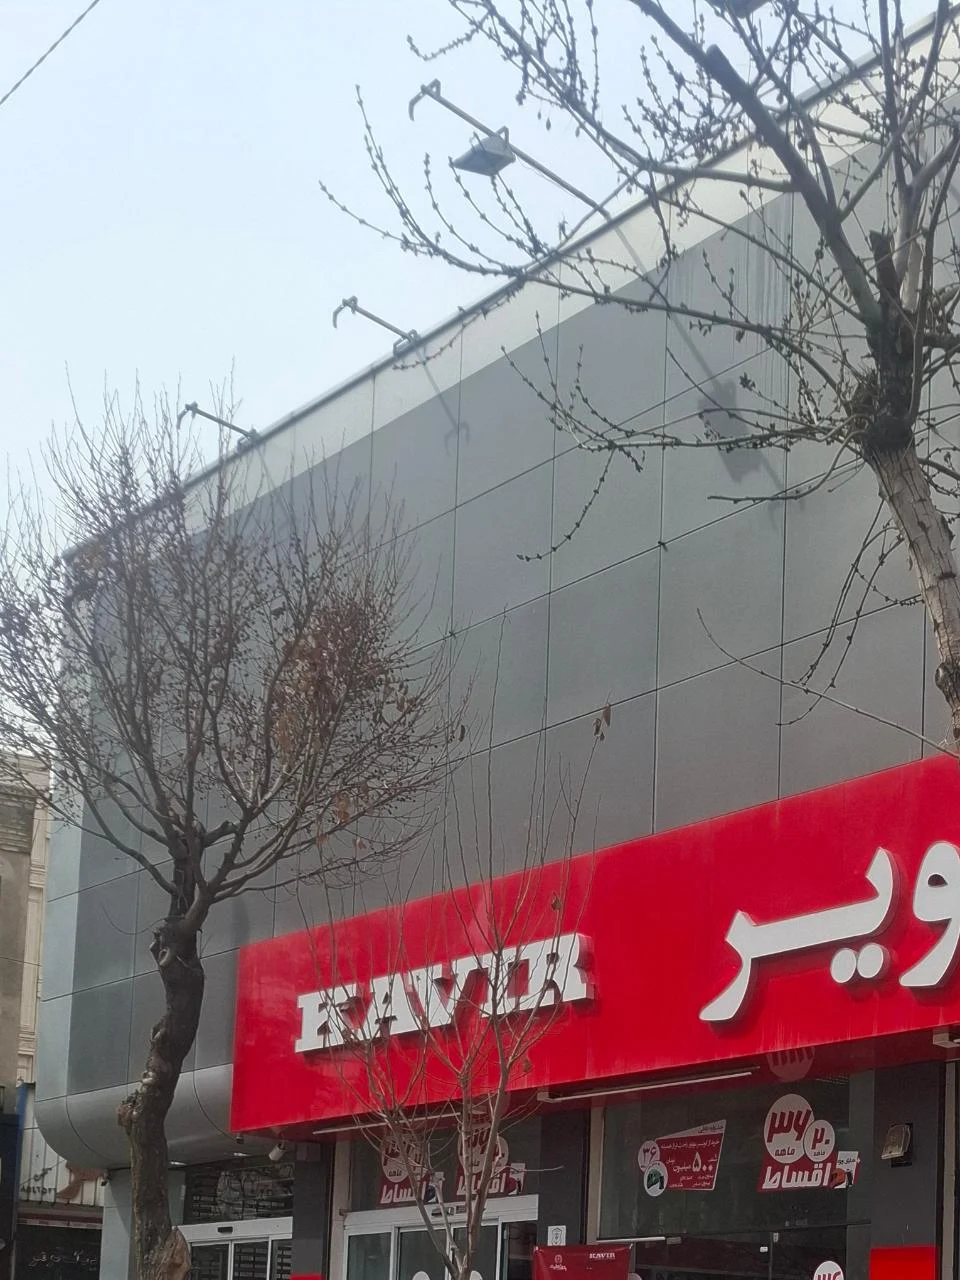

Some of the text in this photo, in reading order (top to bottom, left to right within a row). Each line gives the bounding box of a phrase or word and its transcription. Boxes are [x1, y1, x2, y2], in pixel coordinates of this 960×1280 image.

[295, 932, 596, 1054] KAVIR
[767, 1109, 812, 1143] ۳۶
[811, 1127, 831, 1150] ۲۰
[692, 1151, 714, 1173] ۵۰۰
[774, 1146, 796, 1157] ماهه
[761, 1162, 832, 1190] اقساط
[589, 1252, 616, 1260] KAVIR
